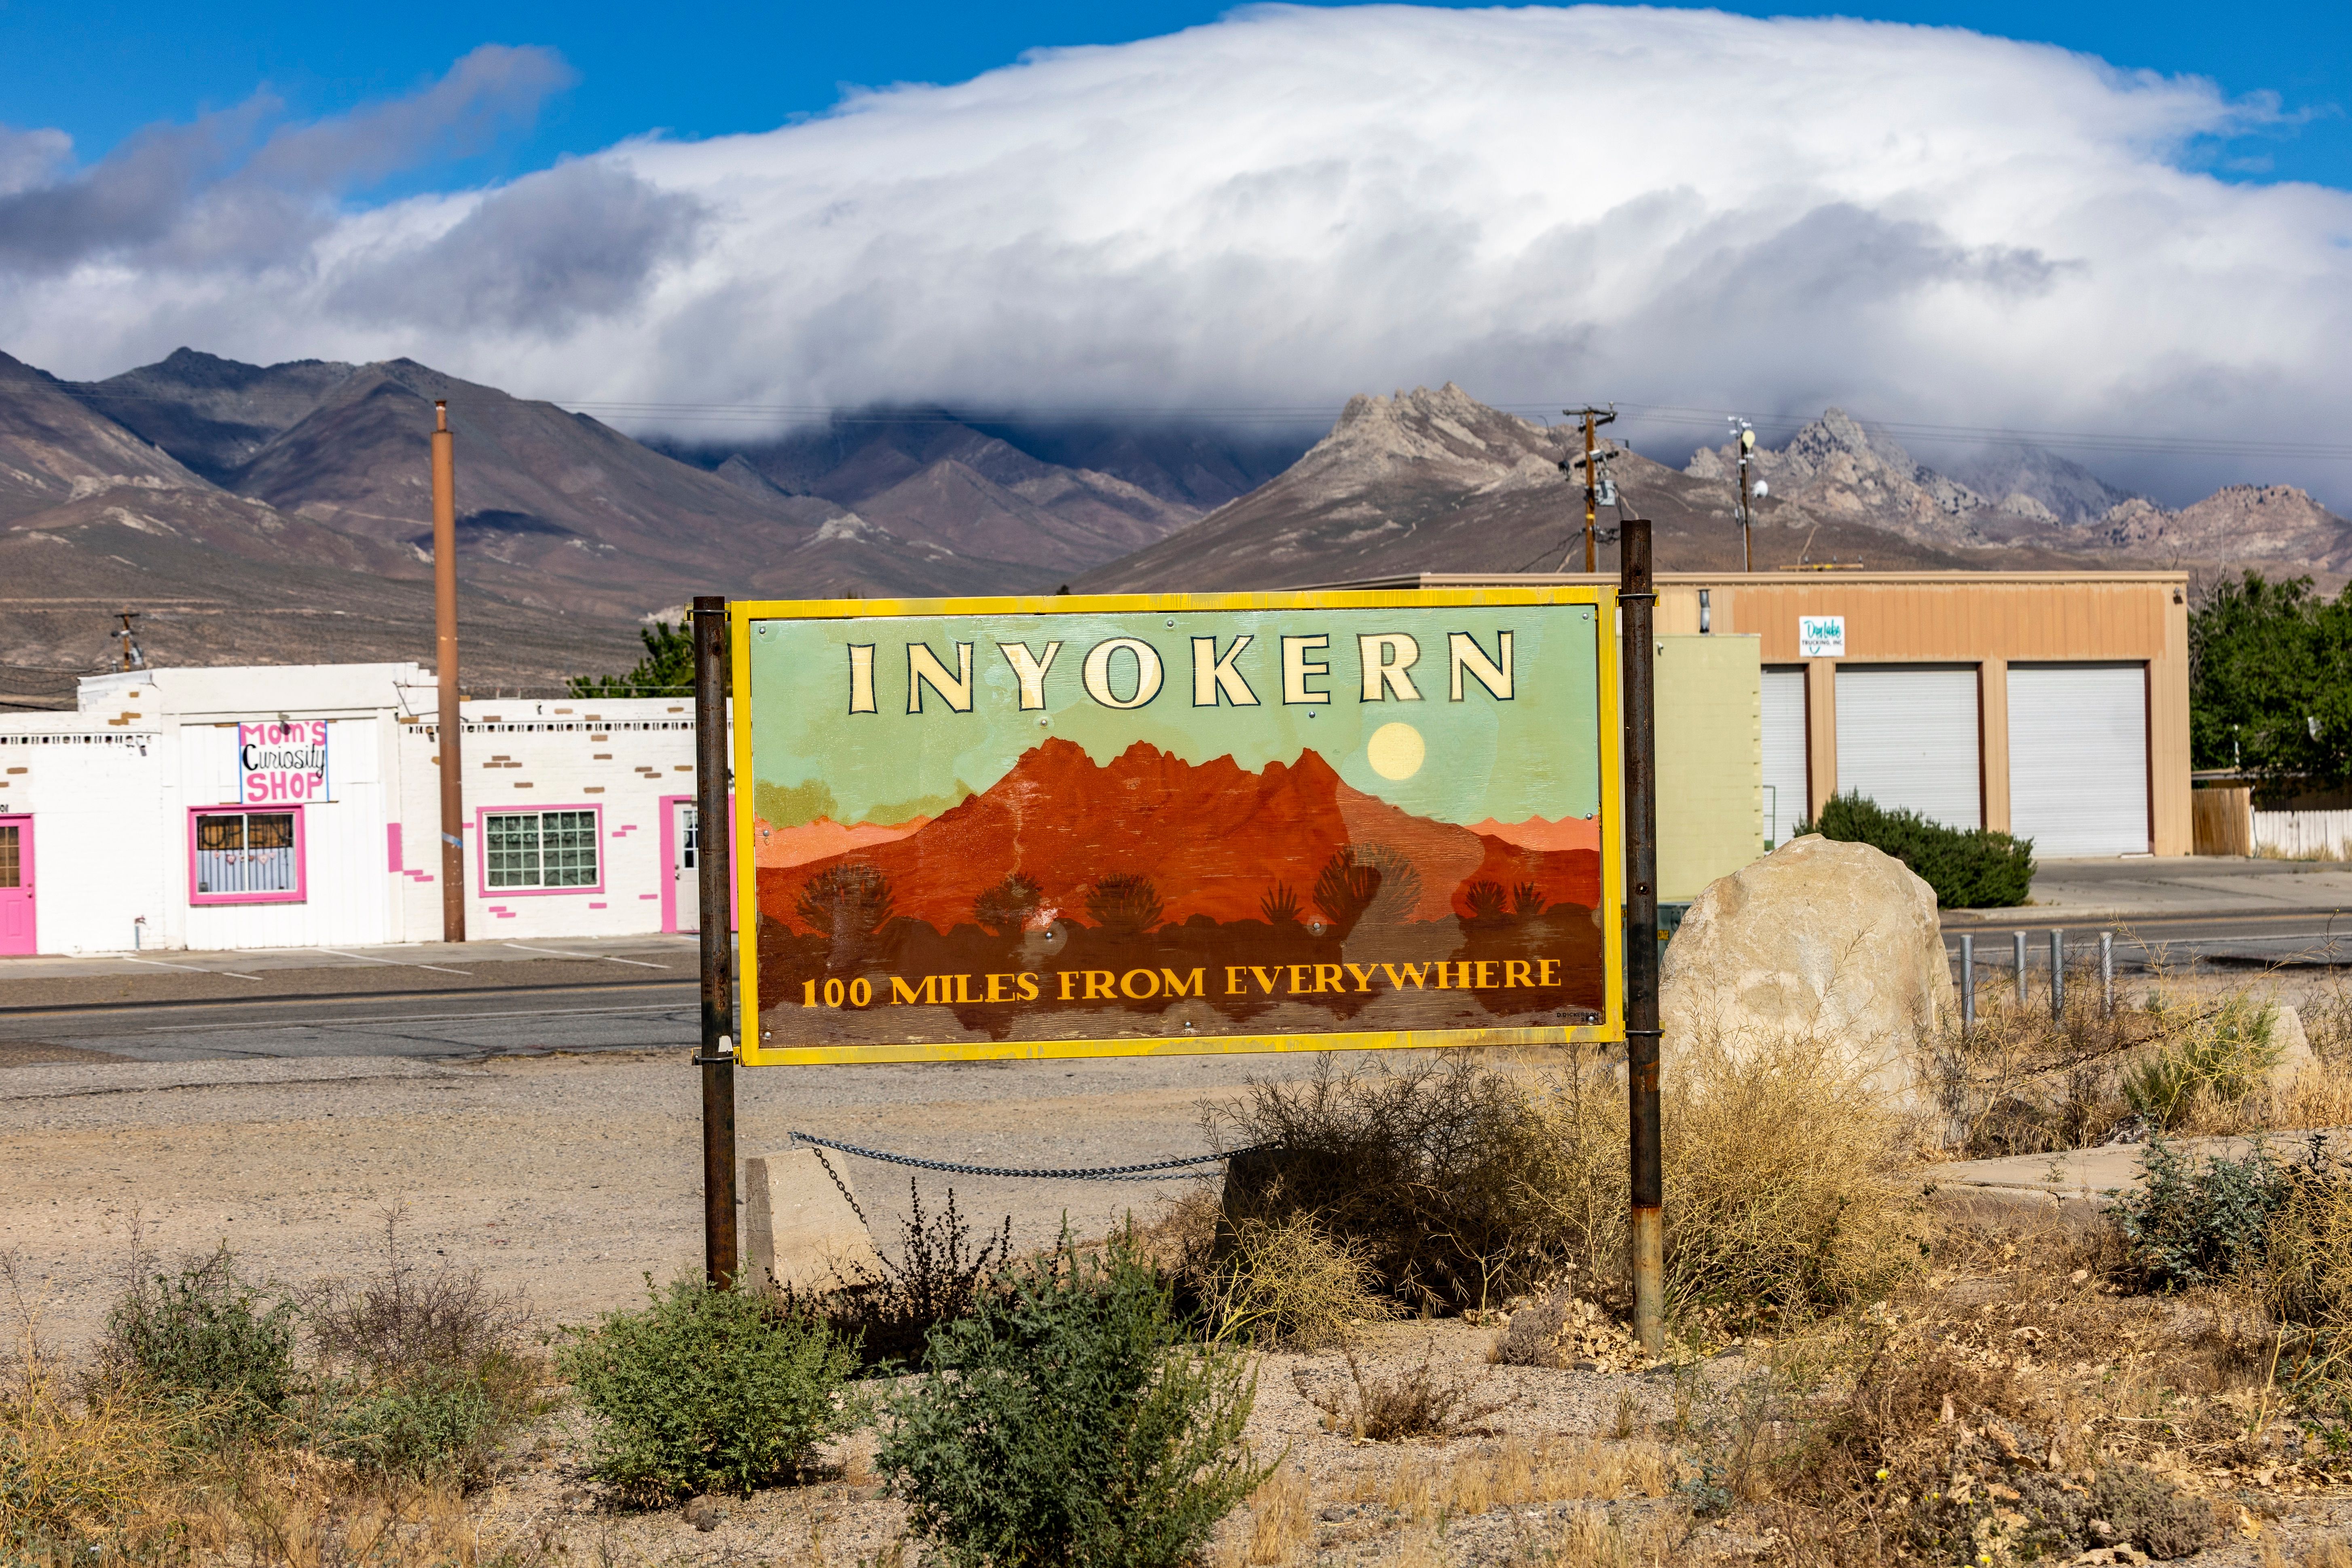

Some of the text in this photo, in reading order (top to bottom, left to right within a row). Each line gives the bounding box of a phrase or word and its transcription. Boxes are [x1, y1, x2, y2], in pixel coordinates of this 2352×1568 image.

[1804, 620, 1822, 654] Dry
[847, 630, 1514, 716] INYOKERN
[243, 743, 325, 779] Curiosity
[246, 771, 323, 802] SHOP
[802, 959, 1561, 1008] 100 MILES FROM EVERYWHERE
